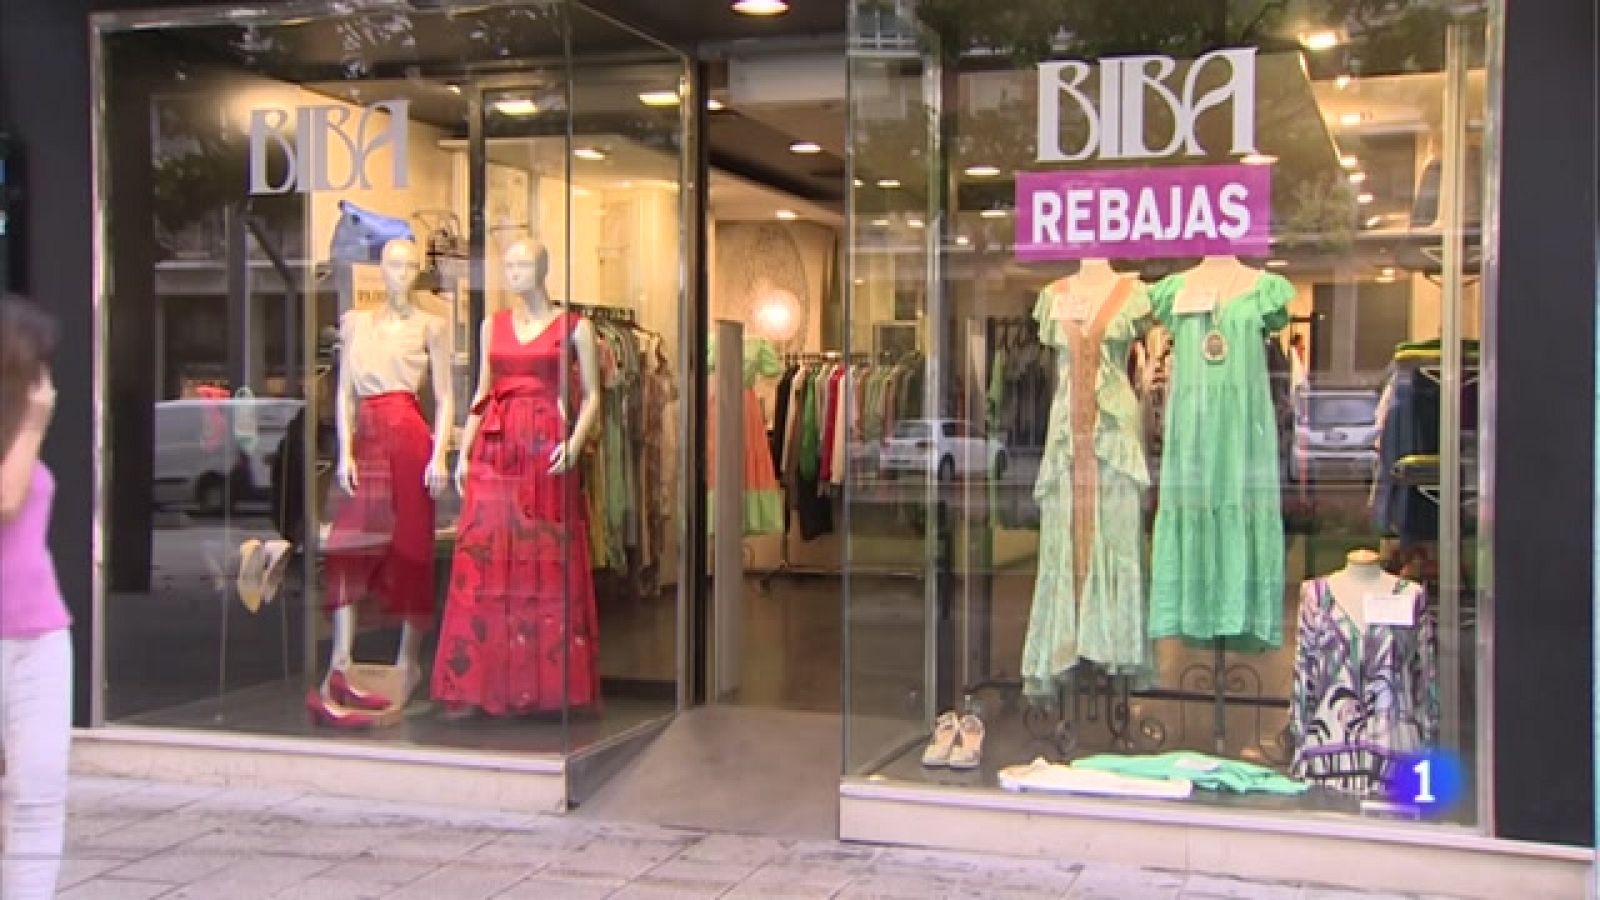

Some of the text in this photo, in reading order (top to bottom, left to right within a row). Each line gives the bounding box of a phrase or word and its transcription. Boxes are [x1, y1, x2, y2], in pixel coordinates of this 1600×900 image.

[250, 100, 409, 194] BIBA
[1036, 47, 1258, 162] BIBA
[1032, 182, 1250, 243] REBAJAS
